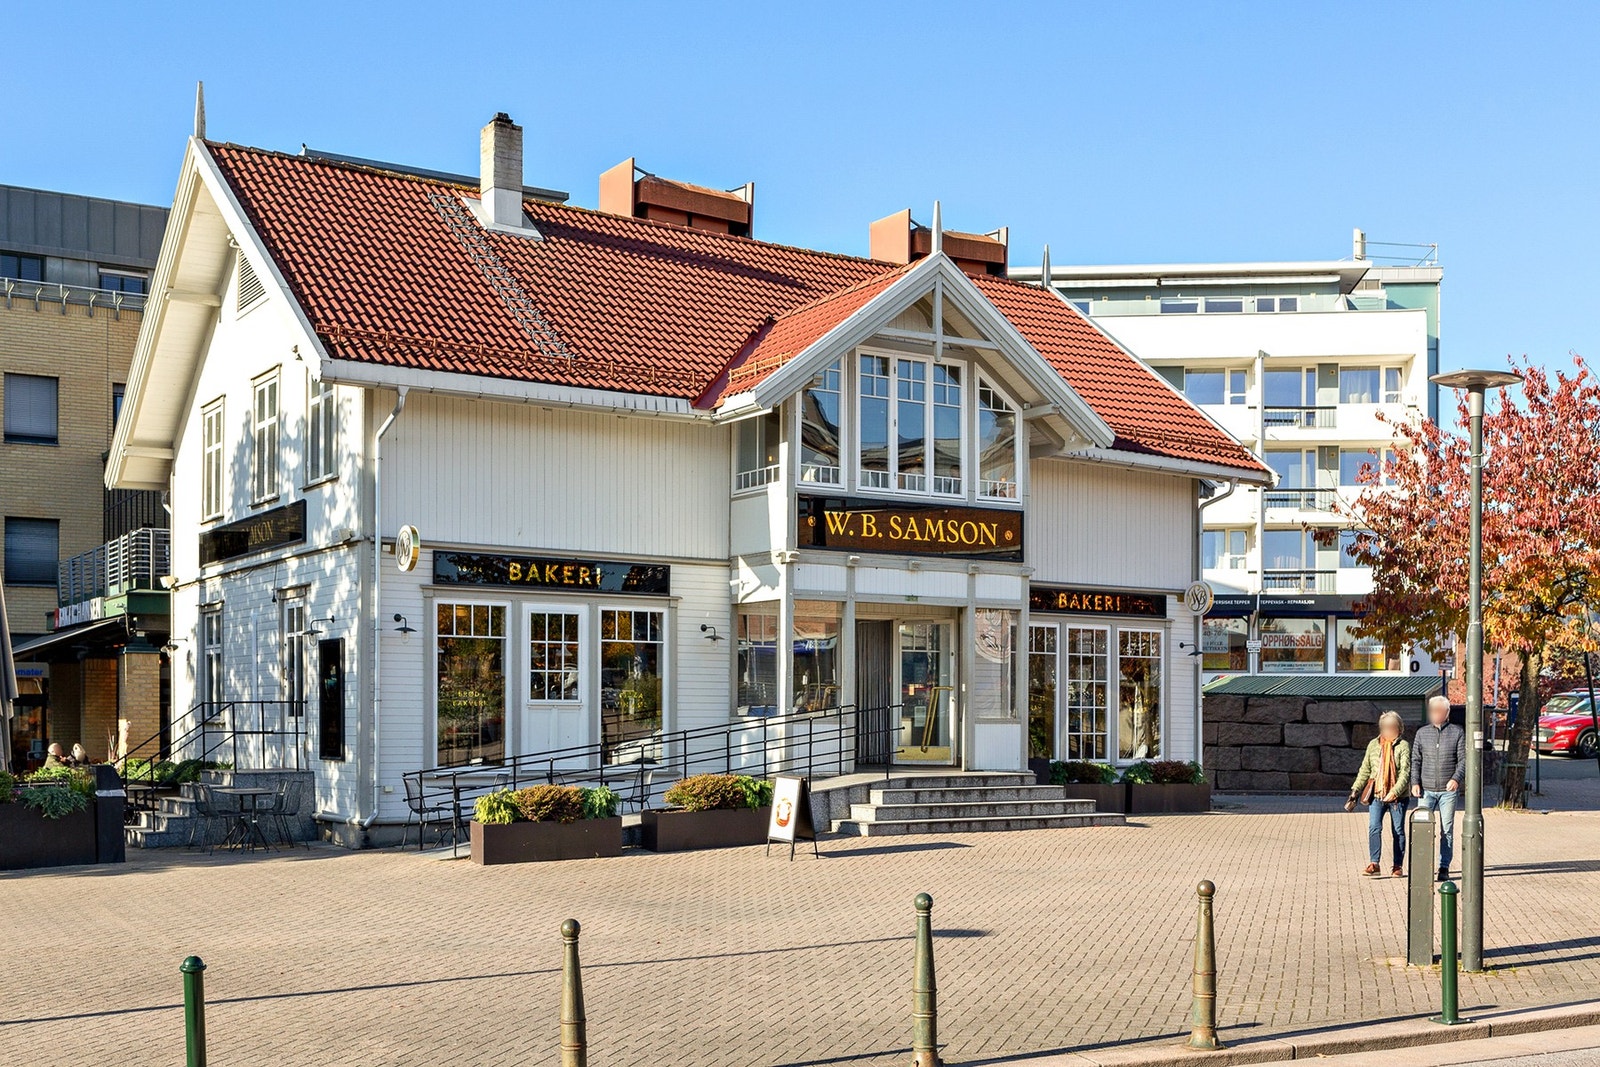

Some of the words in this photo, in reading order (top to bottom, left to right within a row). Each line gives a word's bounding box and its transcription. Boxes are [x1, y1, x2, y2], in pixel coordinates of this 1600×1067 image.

[823, 510, 854, 536] W.
[861, 513, 883, 539] B.
[889, 515, 999, 546] SAMSON
[508, 562, 601, 586] BAKERI
[1058, 592, 1121, 611] BAKERI
[1262, 634, 1322, 647] OPPHØRSSALG
